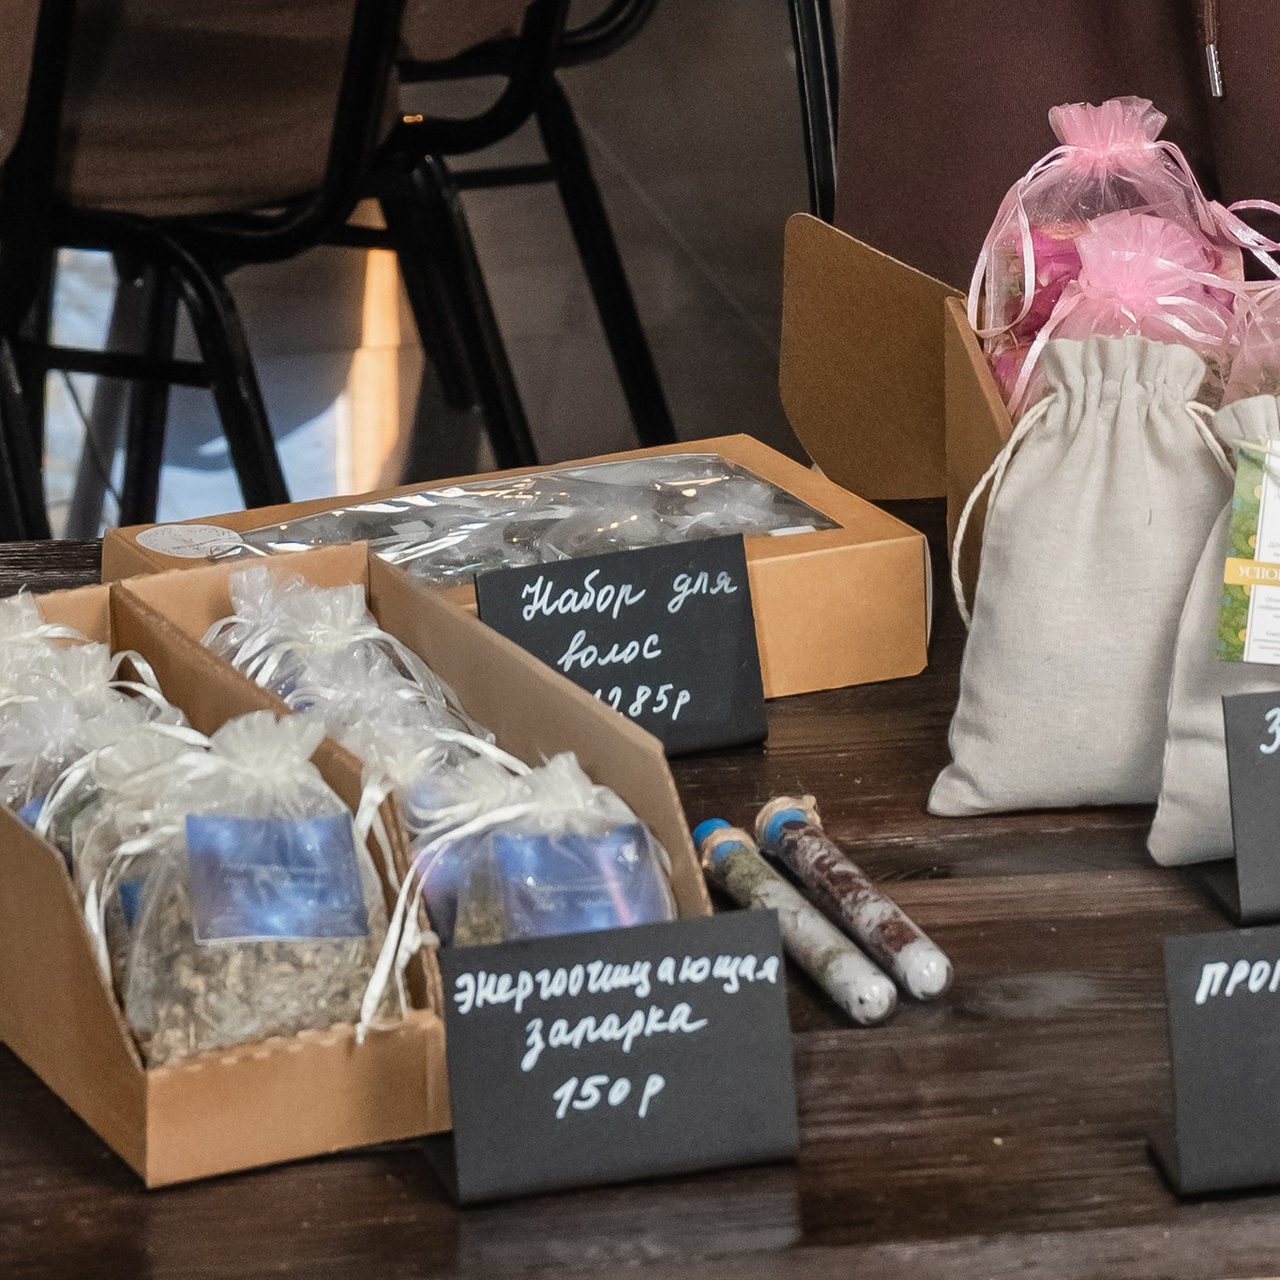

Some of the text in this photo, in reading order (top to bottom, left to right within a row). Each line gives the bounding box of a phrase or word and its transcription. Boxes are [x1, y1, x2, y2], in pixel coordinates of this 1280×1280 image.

[521, 568, 738, 622] Набор для
[556, 629, 662, 672] волос
[519, 1002, 708, 1072] запарка
